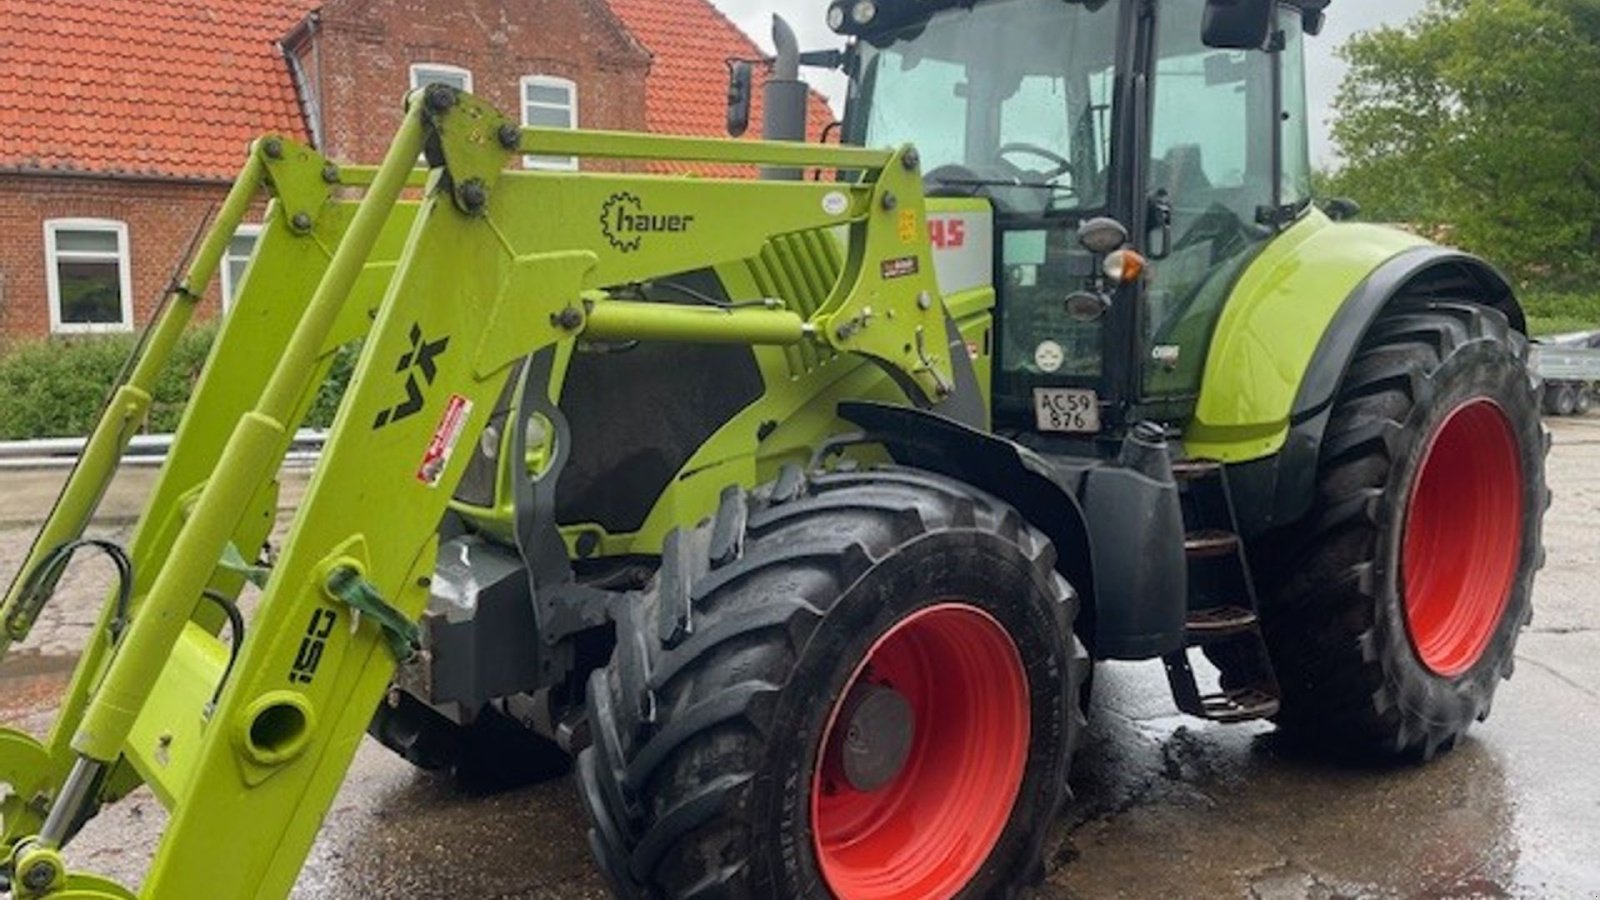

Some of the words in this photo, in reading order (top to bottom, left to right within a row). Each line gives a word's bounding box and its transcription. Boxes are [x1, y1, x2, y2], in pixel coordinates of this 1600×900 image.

[618, 206, 694, 232] hauer
[372, 321, 450, 430] VX
[1042, 394, 1090, 411] AC59
[1050, 412, 1085, 429] 876
